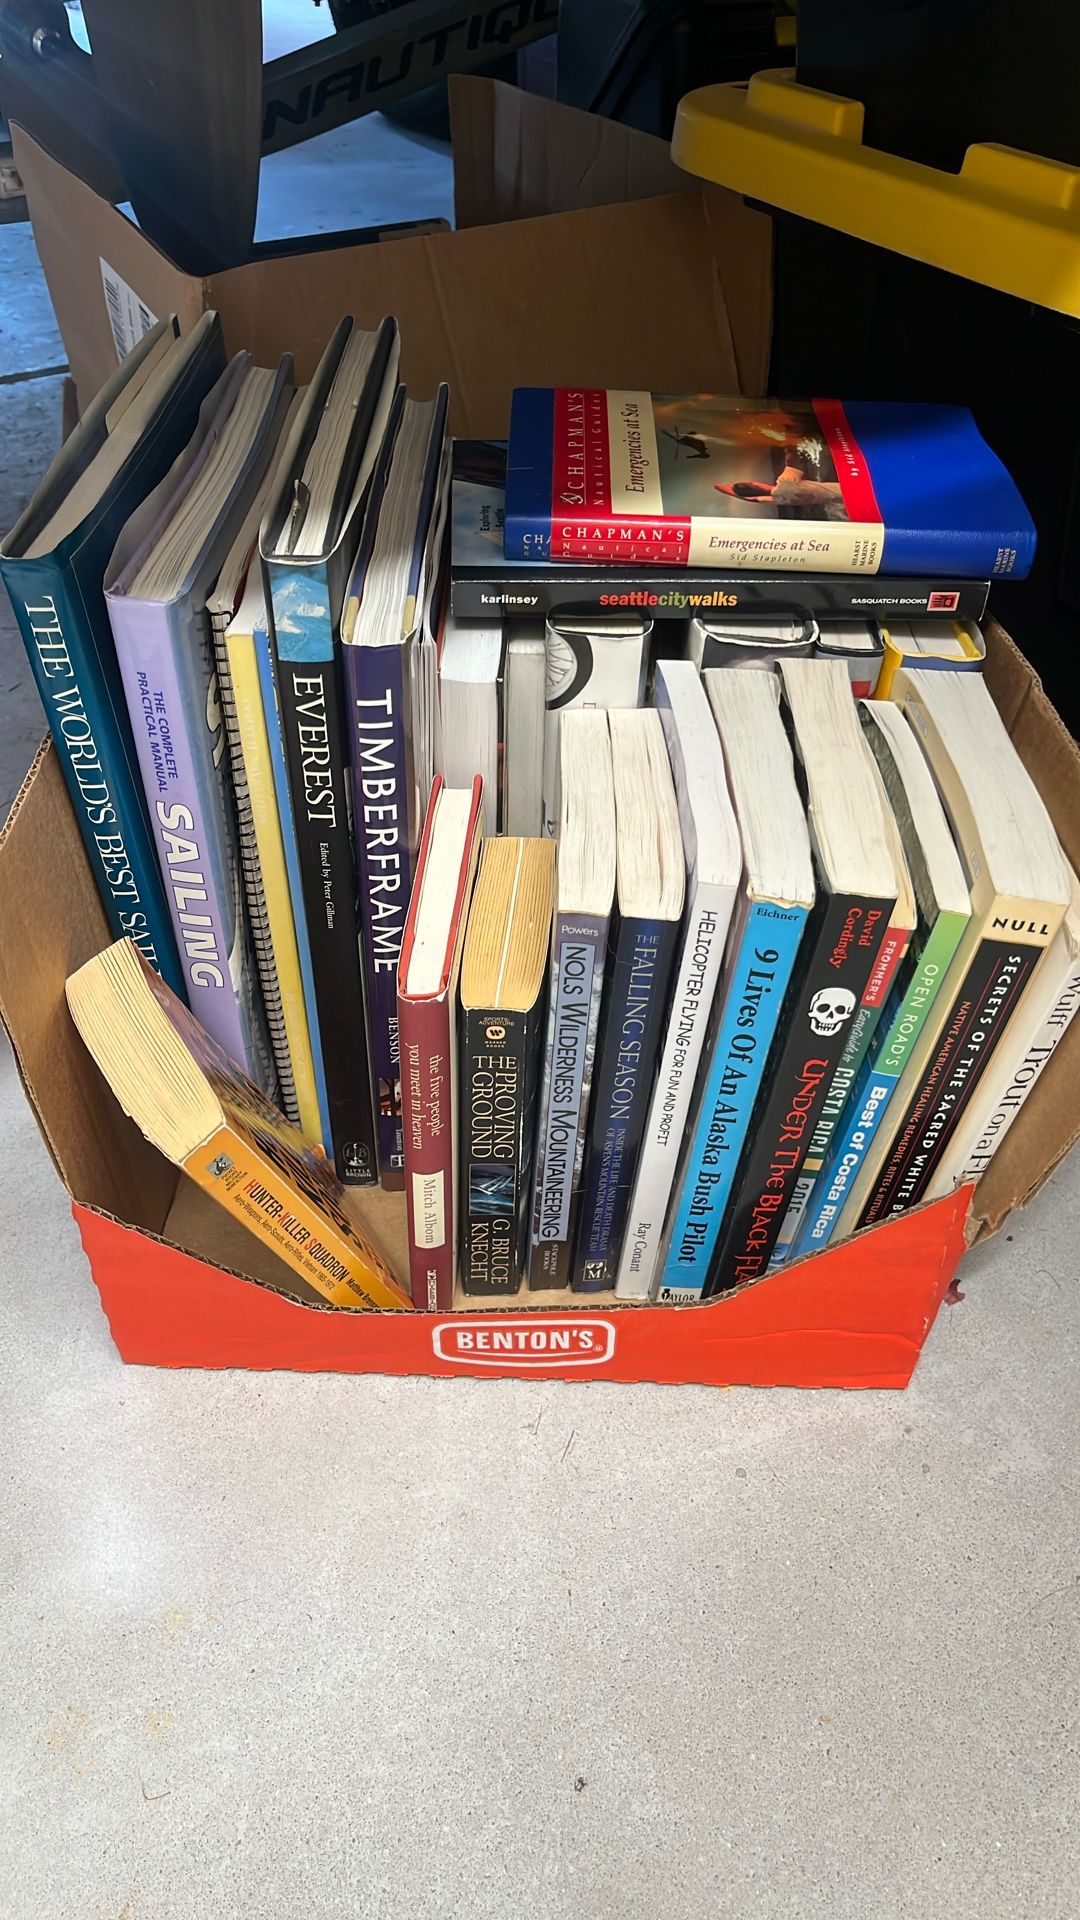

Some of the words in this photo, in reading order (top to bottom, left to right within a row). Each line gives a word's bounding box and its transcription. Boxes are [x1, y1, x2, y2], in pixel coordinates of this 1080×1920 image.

[620, 402, 639, 418] Sea
[623, 417, 640, 430] at
[567, 392, 584, 491] CHAPMAN'S
[622, 432, 650, 494] Emergencies
[562, 526, 685, 542] CHAPMAN'S
[562, 543, 683, 553] Nautical
[708, 537, 788, 553] Emergencies
[790, 540, 805, 551] at
[807, 540, 831, 552] Sea
[730, 553, 747, 562] Sid
[752, 554, 807, 564] Stapleton
[851, 540, 861, 566] HEARST
[860, 540, 869, 566] MARINE
[868, 542, 877, 565] BOOKS
[992, 548, 1004, 574] HEARST
[1006, 549, 1017, 572] BOOKS
[481, 593, 539, 607] karlinsey
[600, 591, 738, 608] seattlecitywalks
[153, 690, 166, 715] THE
[136, 671, 156, 739] PRACTICAL
[150, 741, 167, 793] MANUAL
[24, 595, 73, 678] THE
[51, 684, 117, 825] WORLD'S
[93, 830, 141, 904] BEST
[158, 717, 178, 780] COMPLETE
[292, 673, 337, 828] EVEREST
[357, 689, 402, 974] TIMBERFRAME
[319, 842, 331, 867] Edited
[320, 868, 332, 878] by
[156, 800, 225, 989] SAILING
[323, 881, 333, 900] Peter
[325, 901, 336, 929] Gillman
[756, 907, 800, 921] Eichner
[858, 908, 883, 947] David
[992, 917, 1050, 936] NULL
[561, 925, 599, 937] Powers
[634, 934, 661, 945] THE
[828, 907, 862, 969] Cordingly
[686, 909, 719, 997] HELICOPTER
[754, 948, 779, 967] 9
[564, 946, 588, 995] NOLS
[864, 940, 897, 1002] FROMMER'S
[907, 962, 940, 1007] OPEN
[619, 947, 658, 1036] FALLING
[735, 968, 777, 1029] Lives
[979, 955, 1022, 1026] SECRETS
[675, 999, 699, 1047] FLYING
[849, 1008, 871, 1052] EasyGuide
[954, 1000, 973, 1037] NATIVE
[386, 1016, 401, 1064] BENSON
[405, 1042, 420, 1065] you
[552, 1002, 589, 1104] WILDERNESS
[727, 1036, 758, 1065] Of
[883, 1014, 918, 1067] ROAD'S
[967, 1030, 986, 1052] OF
[429, 1054, 443, 1074] the
[472, 1055, 517, 1069] THE
[671, 1048, 687, 1068] FOR
[844, 1054, 855, 1064] to
[928, 1035, 956, 1086] AMERICAN
[949, 1057, 976, 1089] THE
[999, 1039, 1058, 1109] Trout
[410, 1068, 422, 1096] meet
[430, 1076, 444, 1098] five
[610, 1040, 643, 1120] SEASON
[668, 1069, 682, 1091] FUN
[716, 1065, 749, 1097] An
[822, 1066, 855, 1115] COSTA
[411, 1099, 426, 1110] in
[471, 1072, 494, 1159] GROUND
[493, 1071, 517, 1159] PROVING
[662, 1091, 677, 1112] AND
[778, 1058, 829, 1145] UNDER
[857, 1085, 888, 1128] Best
[909, 1085, 933, 1124] HEALING
[412, 1114, 426, 1150] heaven
[426, 1100, 444, 1136] people
[605, 1127, 615, 1138] OF
[656, 1112, 674, 1147] PROFIT
[700, 1098, 738, 1167] Alaska
[922, 1094, 957, 1149] SACRED
[983, 1113, 1007, 1138] on
[614, 1128, 626, 1152] INSIDE
[807, 1119, 835, 1154] RICA
[849, 1131, 866, 1150] of
[889, 1123, 917, 1166] REMEDIES,
[976, 1138, 992, 1150] a
[540, 1110, 578, 1239] MOUNTAINEERING
[609, 1170, 619, 1184] LIFE
[612, 1154, 622, 1168] THE
[766, 1145, 801, 1189] The
[827, 1150, 860, 1202] Costa
[881, 1166, 898, 1188] RITES
[897, 1153, 929, 1200] WHITE
[423, 1179, 436, 1209] Mitch
[595, 1167, 609, 1207] MOUNTAIN
[606, 1186, 617, 1202] AND
[688, 1168, 722, 1219] Bush
[787, 1182, 810, 1214] 2015
[591, 1208, 604, 1234] RESCUE
[603, 1202, 615, 1224] DEATH
[745, 1193, 784, 1252] BLACK
[811, 1204, 838, 1239] Rica
[865, 1193, 885, 1224] RITUALS
[242, 1178, 312, 1246] HUNTER-KILLER
[304, 1238, 351, 1283] SQUADRON
[345, 1277, 365, 1298] Matthew
[424, 1212, 437, 1244] Albom
[492, 1218, 510, 1236] G.
[588, 1234, 600, 1252] TEAM
[598, 1226, 611, 1252] DRAMA
[636, 1222, 652, 1246] Ray
[677, 1219, 706, 1263] Pilot
[470, 1222, 490, 1283] KNECHT
[490, 1237, 511, 1285] BRUCE
[543, 1250, 551, 1270] BOOKS
[630, 1240, 648, 1272] Conant
[302, 1257, 319, 1275] Vietnam
[316, 1270, 337, 1291] 1965-1972
[456, 1329, 593, 1349] BENTON'S
